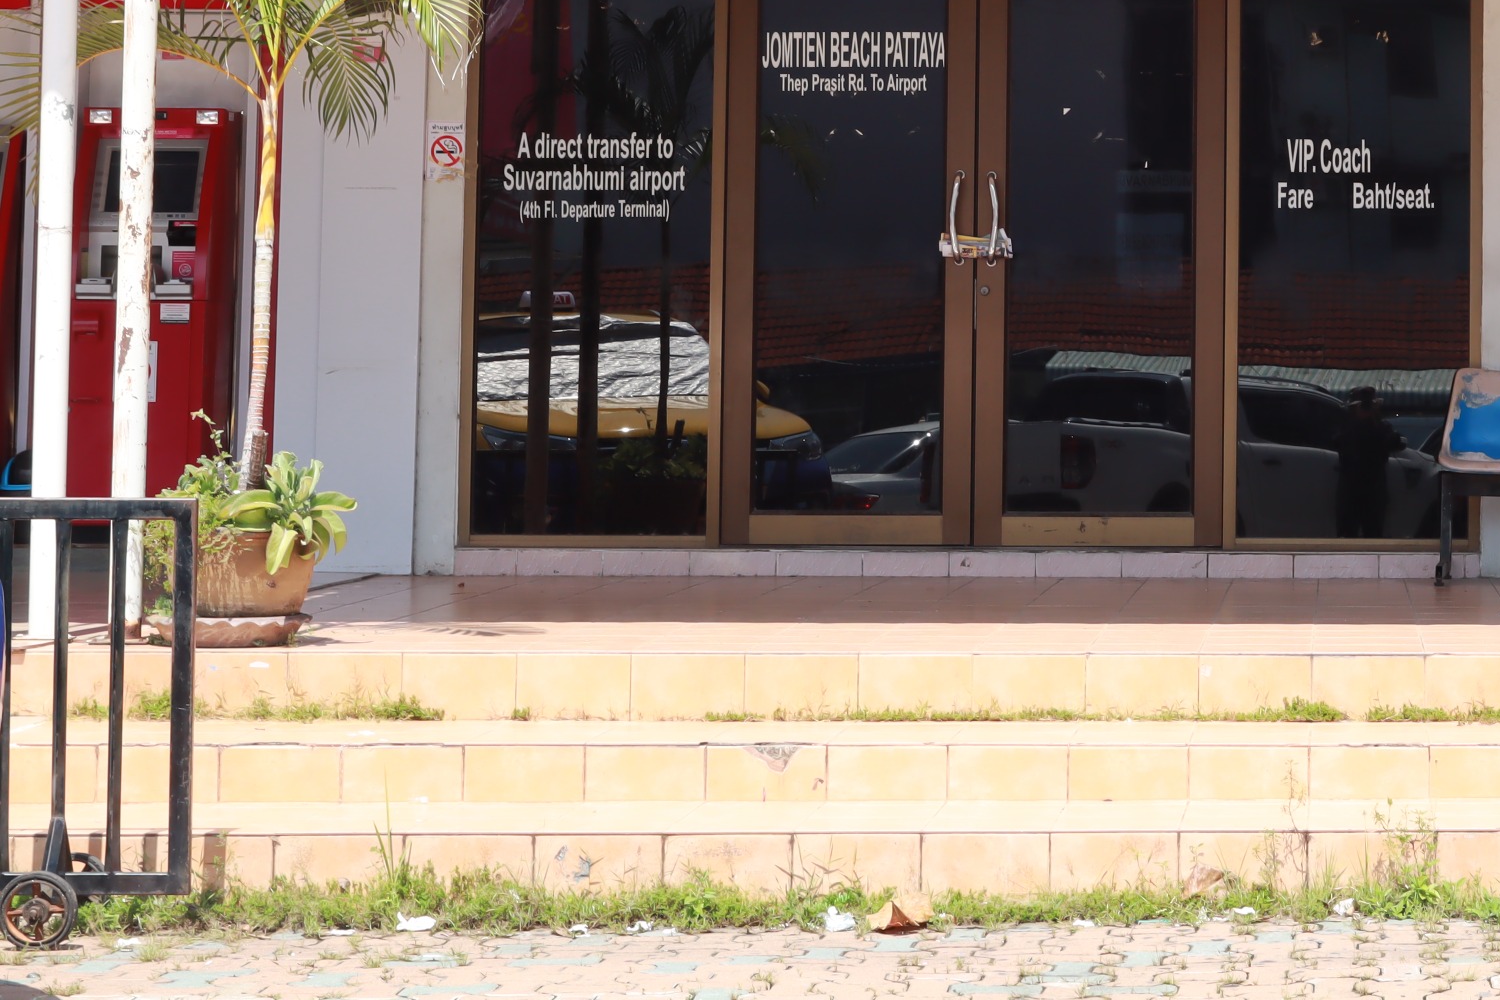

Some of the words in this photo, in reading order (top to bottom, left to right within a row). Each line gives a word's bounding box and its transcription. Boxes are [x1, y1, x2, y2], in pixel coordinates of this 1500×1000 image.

[762, 31, 826, 69] JOMTIEN
[830, 31, 881, 68] BEACH
[885, 31, 946, 68] PATTAYA
[780, 73, 809, 97] Thep
[812, 73, 845, 92] Prasit
[848, 73, 867, 92] Rd.
[870, 73, 885, 92] To
[887, 73, 927, 96] Airport
[517, 131, 531, 159] A
[534, 131, 583, 159] direct
[586, 131, 653, 159] transfer
[656, 132, 674, 159] to
[1287, 138, 1316, 173] VIP.
[1320, 138, 1371, 174] Coach
[503, 164, 625, 191] Suvarnabhumi
[629, 165, 686, 196] airport
[1277, 181, 1314, 209] Fare
[1352, 181, 1435, 210] Baht/seat.
[519, 200, 541, 223] (4th
[561, 200, 616, 222] Departure
[618, 199, 670, 222] Terminal)
